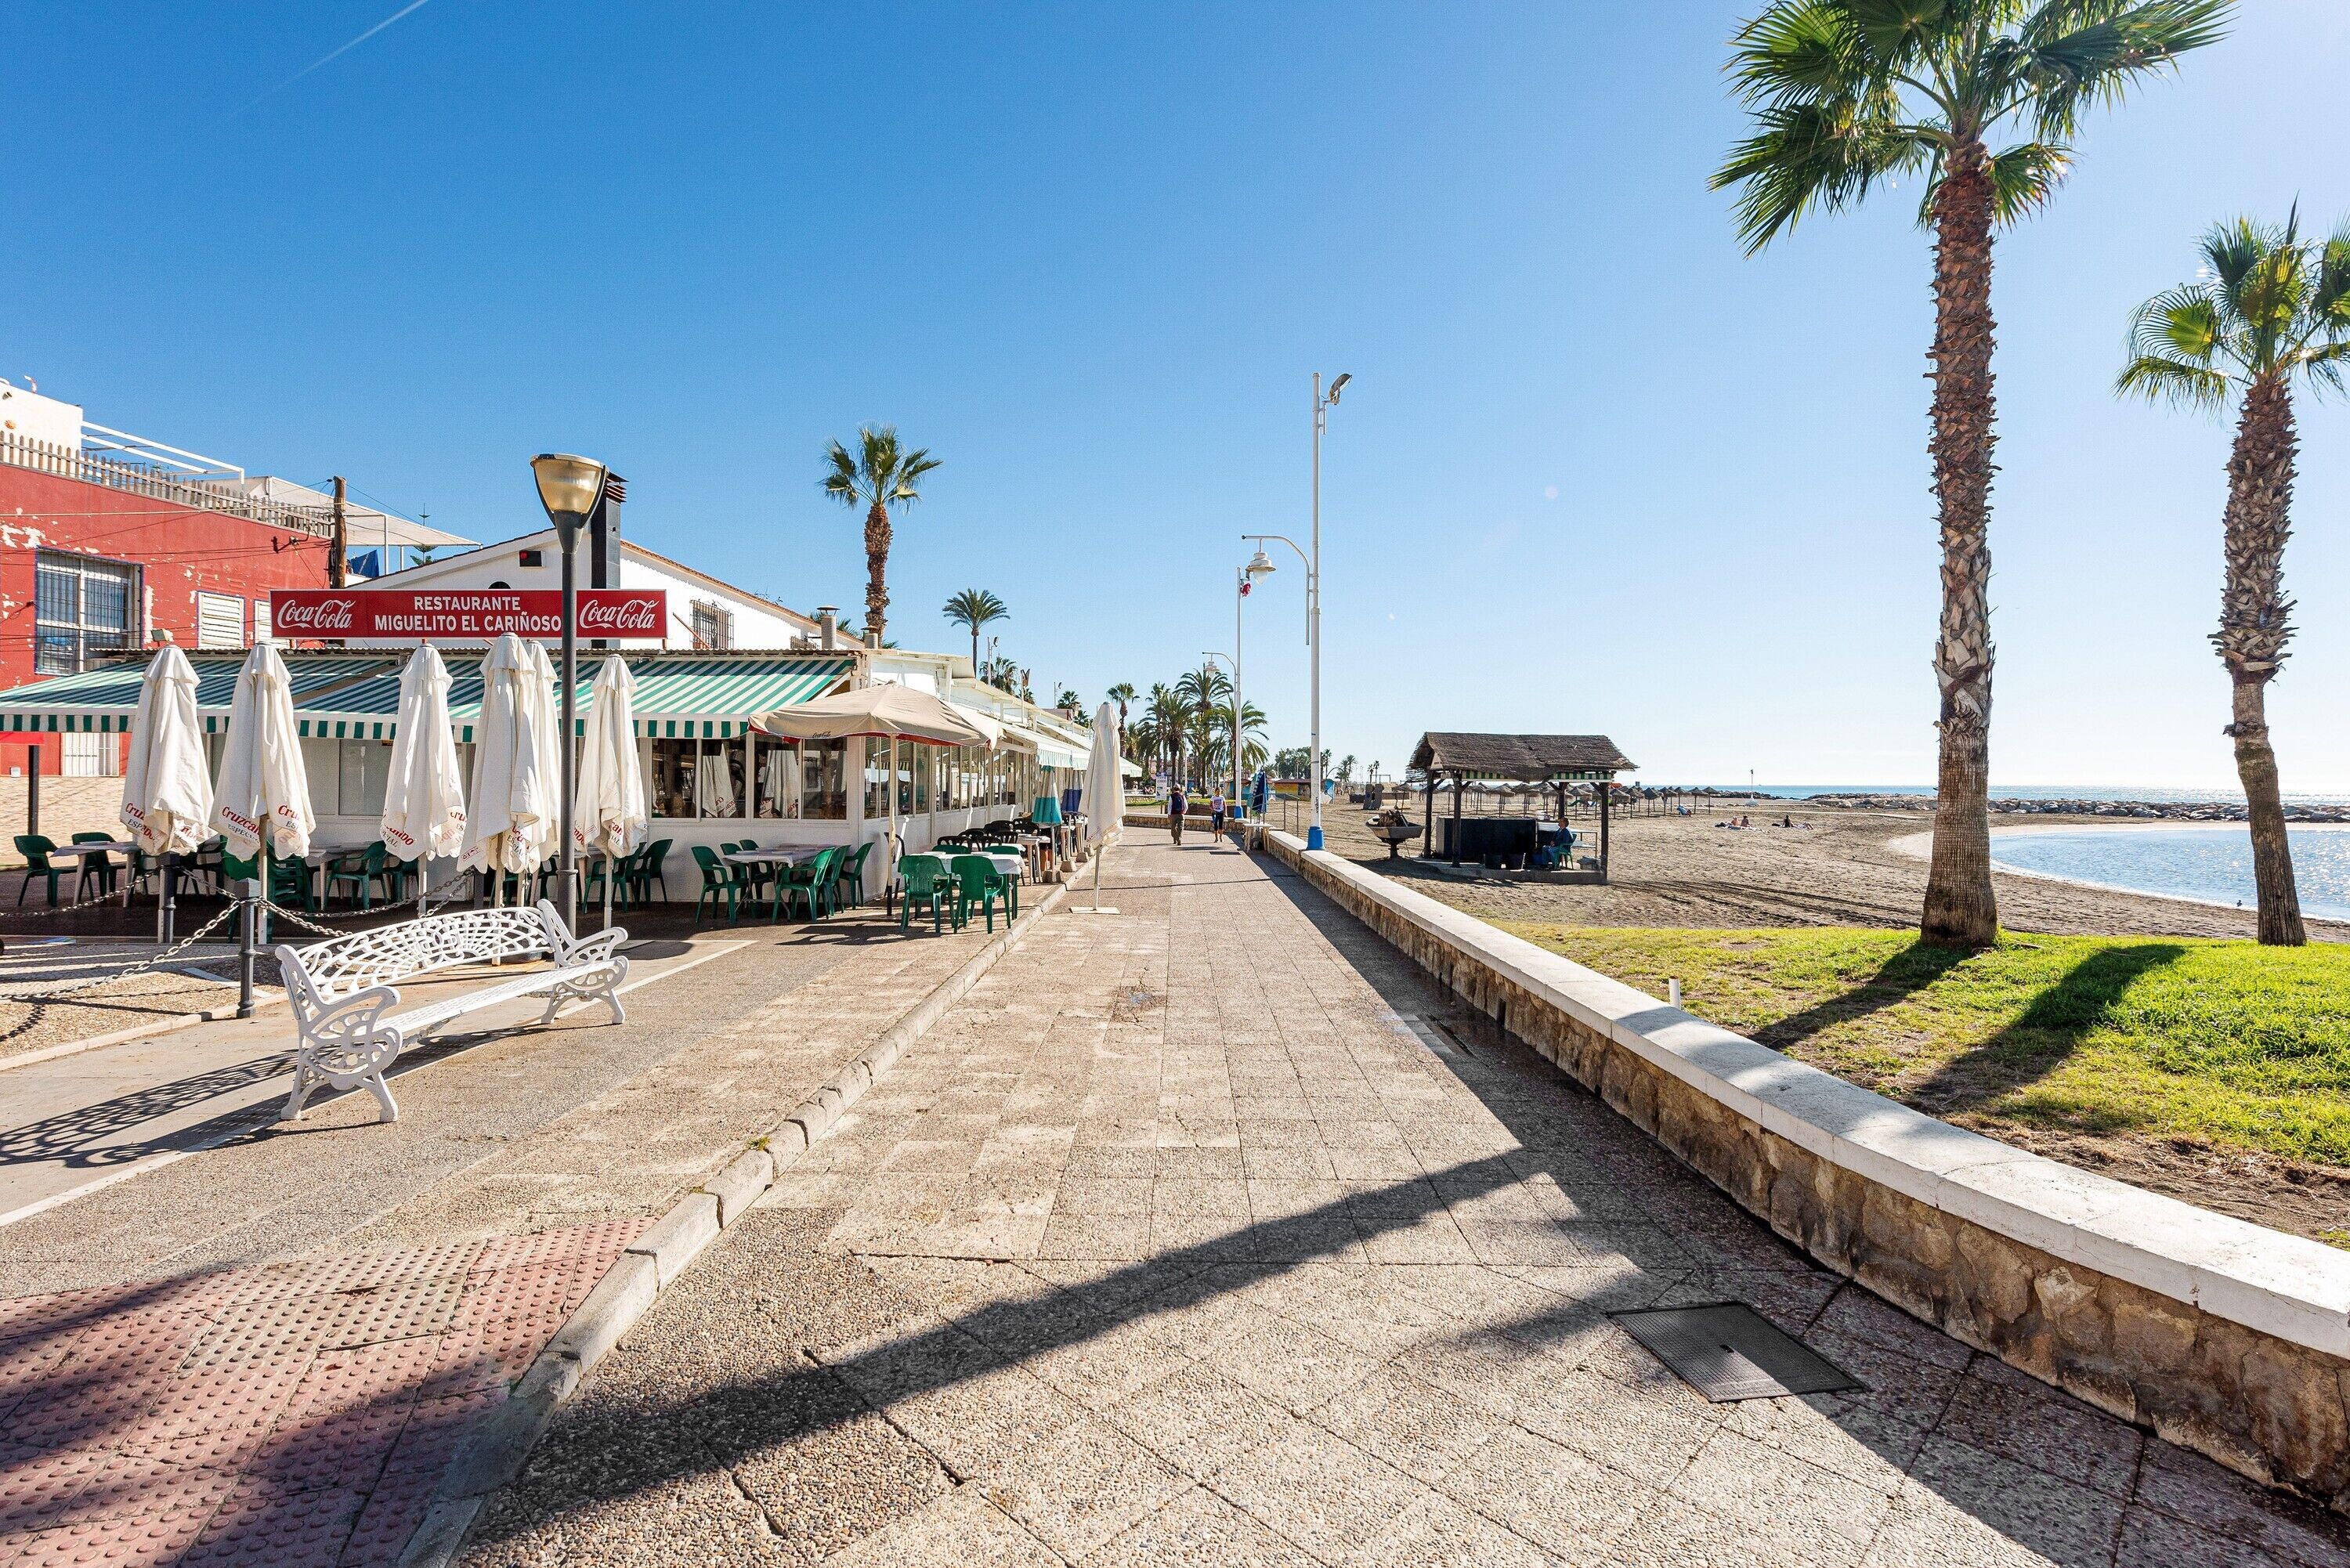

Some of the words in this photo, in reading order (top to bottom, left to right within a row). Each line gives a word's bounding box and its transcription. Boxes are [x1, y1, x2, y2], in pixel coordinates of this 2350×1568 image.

[277, 599, 356, 629] Coca-Cola
[414, 596, 521, 611] RESTAURANTE
[579, 599, 660, 629] Coca-Cola
[374, 614, 457, 631] MIGUELITO
[461, 615, 479, 631] EL
[484, 611, 562, 631] CARIÑOSO
